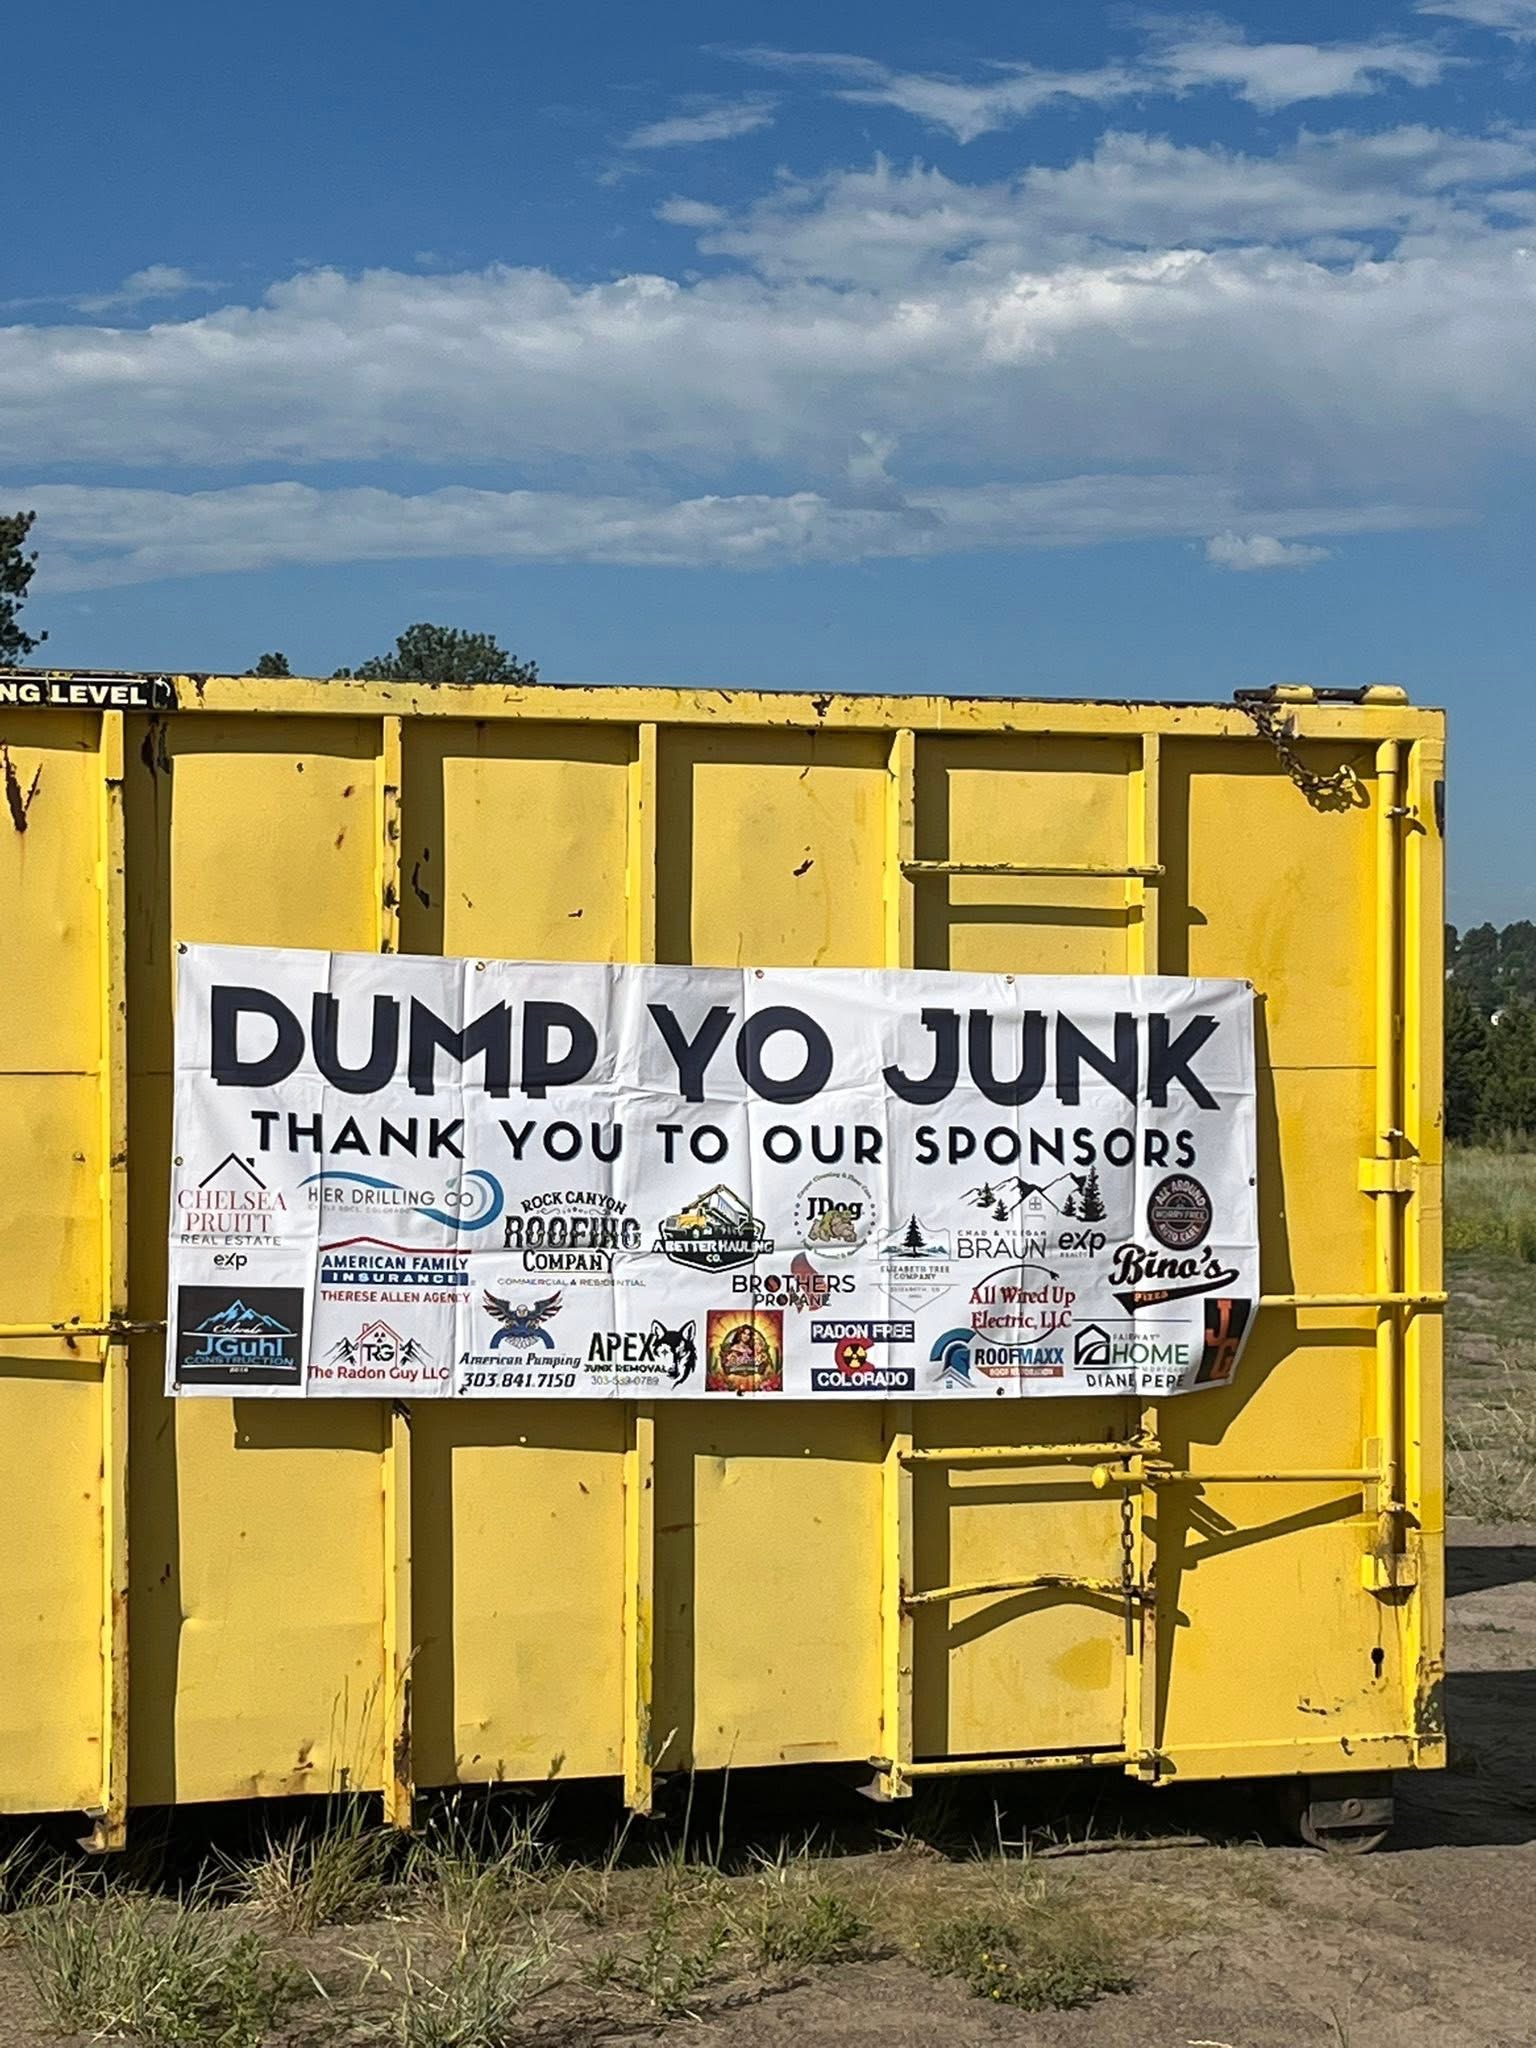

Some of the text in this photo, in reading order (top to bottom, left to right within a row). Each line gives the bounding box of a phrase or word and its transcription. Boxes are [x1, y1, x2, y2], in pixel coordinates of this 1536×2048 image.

[0, 683, 147, 705] NG LEVEL
[211, 985, 1221, 1110] DUMP YO JUNK
[252, 1110, 1197, 1168] THANK YOU TO OUR SPONSORS
[177, 1188, 288, 1212] CHELSEA
[352, 1189, 436, 1206] DRILLING
[444, 1192, 475, 1207] CO
[520, 1190, 628, 1215] ROCK CANYON
[806, 1197, 863, 1221] JDog
[185, 1212, 273, 1233] PRUITT
[181, 1234, 281, 1246] REAL ESTATE
[503, 1215, 642, 1249] ROOFING
[665, 1240, 717, 1252] BETTER
[718, 1240, 773, 1252] HAULING
[957, 1238, 1047, 1260] BRAUN
[1058, 1229, 1107, 1258] exp
[213, 1252, 248, 1270] exp
[321, 1255, 468, 1271] AMERICAN FAMILY
[929, 1265, 950, 1273] TREE
[1108, 1243, 1221, 1285] Bino's
[332, 1273, 458, 1285] INSURANCE
[732, 1275, 856, 1293] BROTHERS
[321, 1291, 377, 1303] THERESE
[379, 1291, 421, 1303] ALLEN
[754, 1293, 832, 1307] PROPANE
[969, 1285, 1076, 1308] All Wired Up
[971, 1310, 1073, 1330] Electric, LLC
[813, 1324, 913, 1338] RADON FREE
[195, 1336, 283, 1356] JGuhl
[362, 1343, 395, 1361] TRG
[588, 1332, 656, 1361] APEX
[1112, 1343, 1189, 1365] HOME
[184, 1355, 295, 1366] CONSTRUCTION
[459, 1352, 582, 1369] American Pumping
[975, 1347, 1064, 1365] ROOFMAXX
[307, 1366, 450, 1382] The Radon Guy LLC
[584, 1364, 668, 1373] JUNK REMOVAL
[464, 1372, 576, 1388] 303.841.7150
[817, 1371, 908, 1387] COLORADO
[1086, 1374, 1185, 1388] DIANE PEPE
